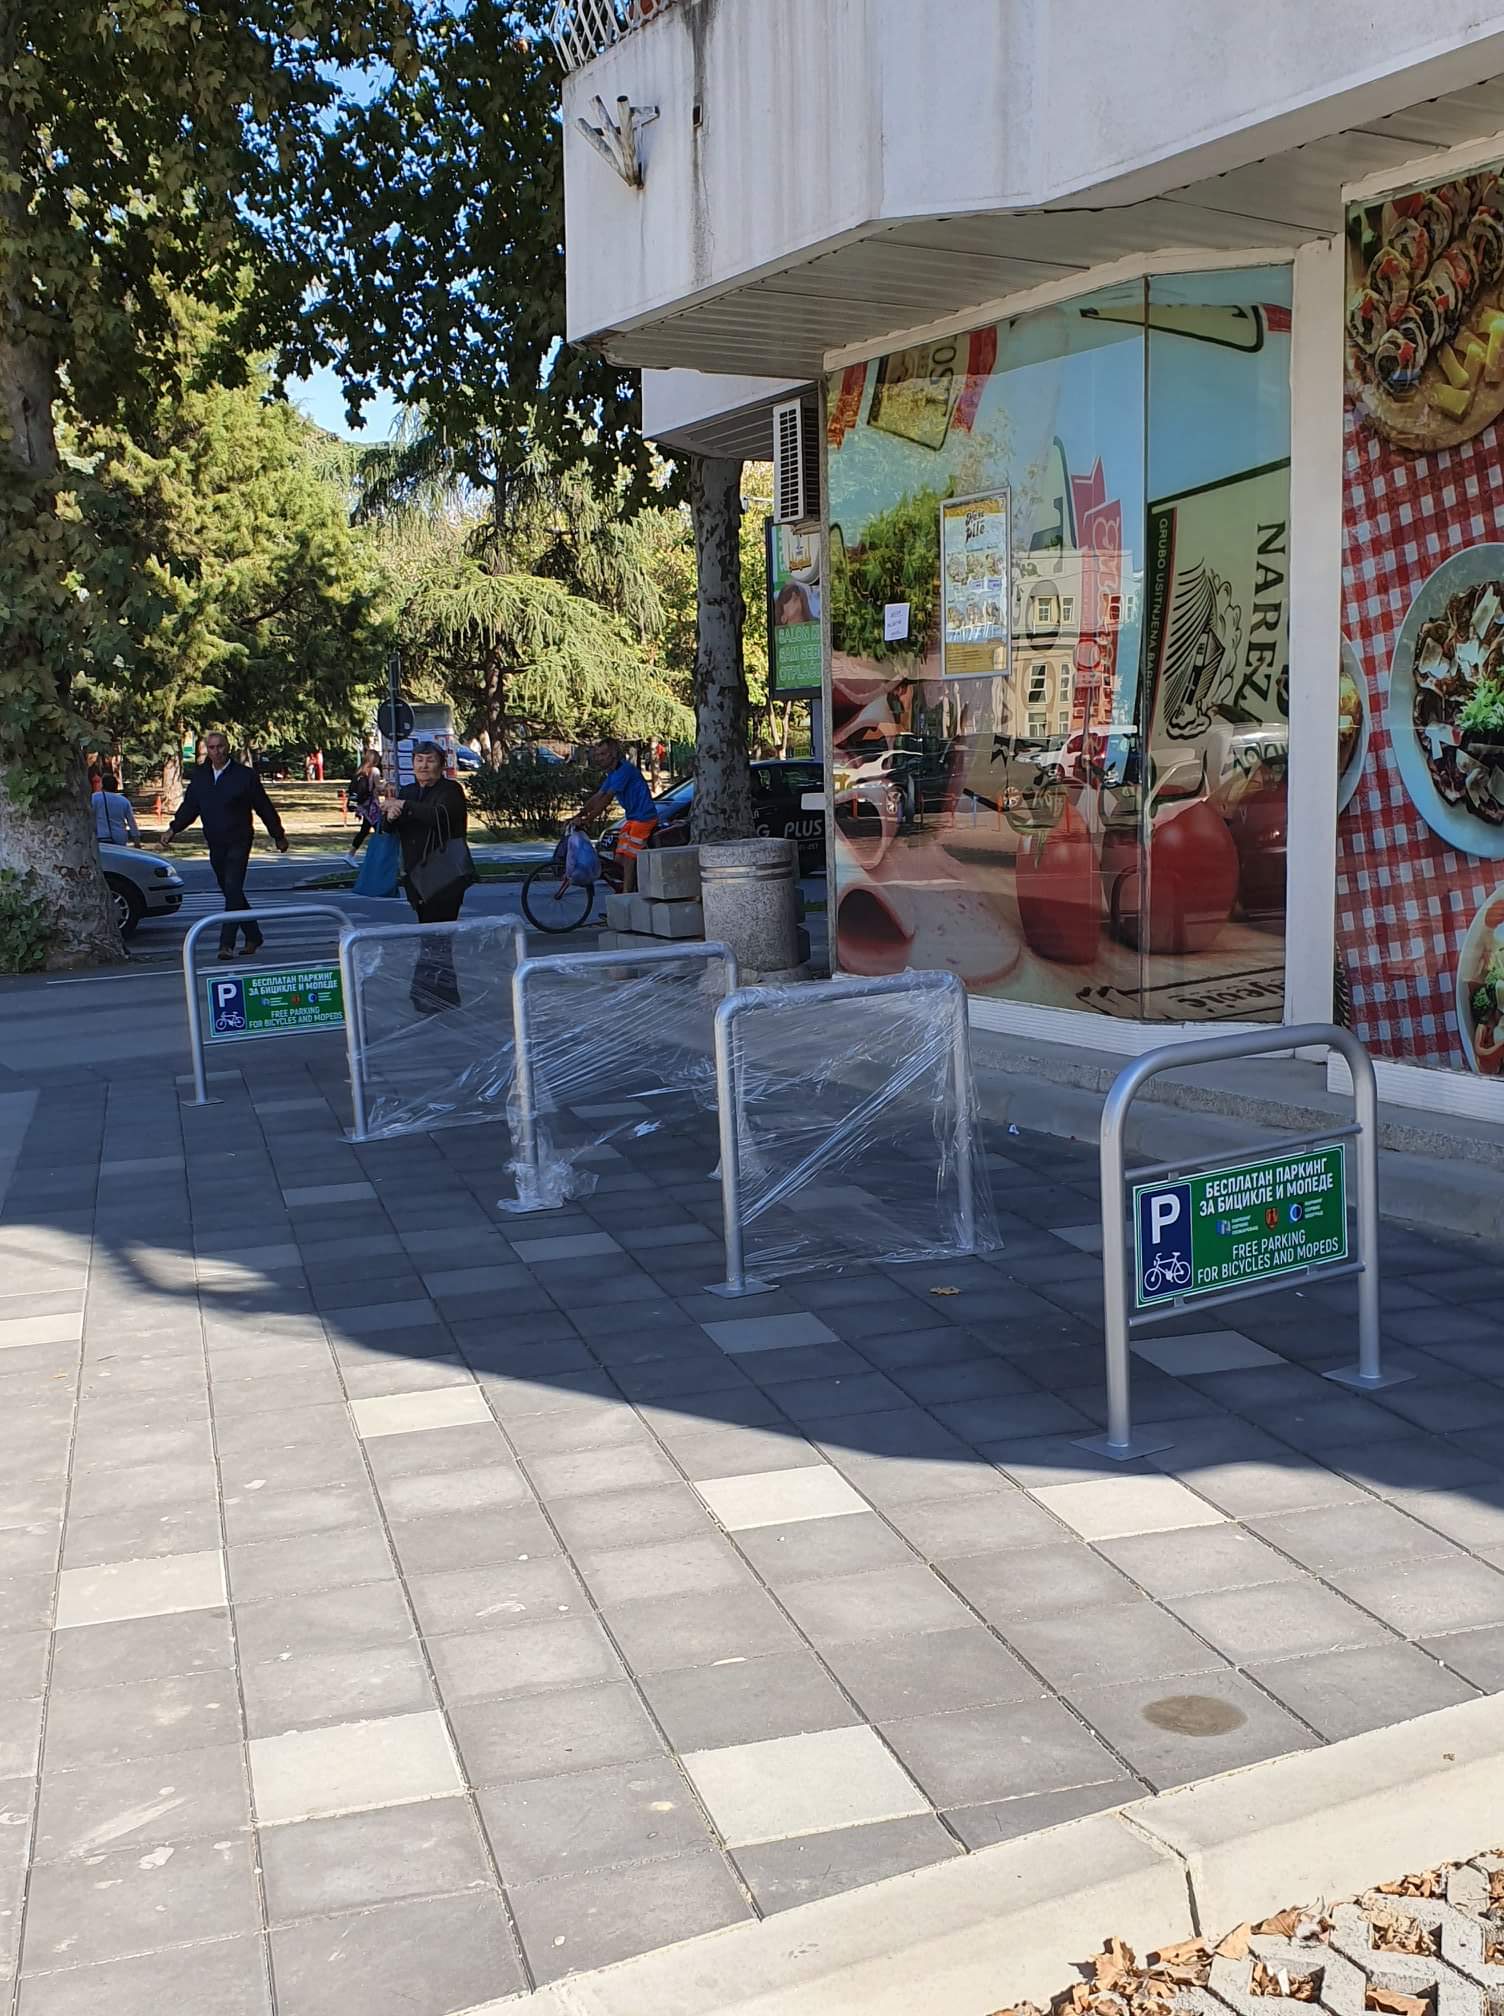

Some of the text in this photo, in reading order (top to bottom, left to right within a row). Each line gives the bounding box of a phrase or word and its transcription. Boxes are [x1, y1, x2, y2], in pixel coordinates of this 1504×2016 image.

[1156, 518, 1168, 569] GRUBO
[1148, 572, 1165, 648] USITNJENA
[784, 819, 823, 838] PLUS
[248, 980, 338, 996] ЗА БИЦИКЛЕ И МОПЕДЕ
[252, 972, 333, 988] БЕСПЛАТАН ПАРКИНГ
[218, 983, 236, 1008] P
[248, 1011, 343, 1029] FOR BICYCLES AND MOPEDS
[271, 1006, 320, 1018] FREE PARKING
[1206, 1158, 1328, 1198] БЕСПЛАТАН ПАРКИНГ
[1200, 1172, 1334, 1217] ЗА БИЦИКЛЕ И МОПЕДЕ
[1151, 1194, 1180, 1244] P
[1232, 1239, 1258, 1260] FREE
[1261, 1230, 1306, 1253] PARKING
[1197, 1237, 1339, 1284] FOR BICYCLES AND MOPEDS
